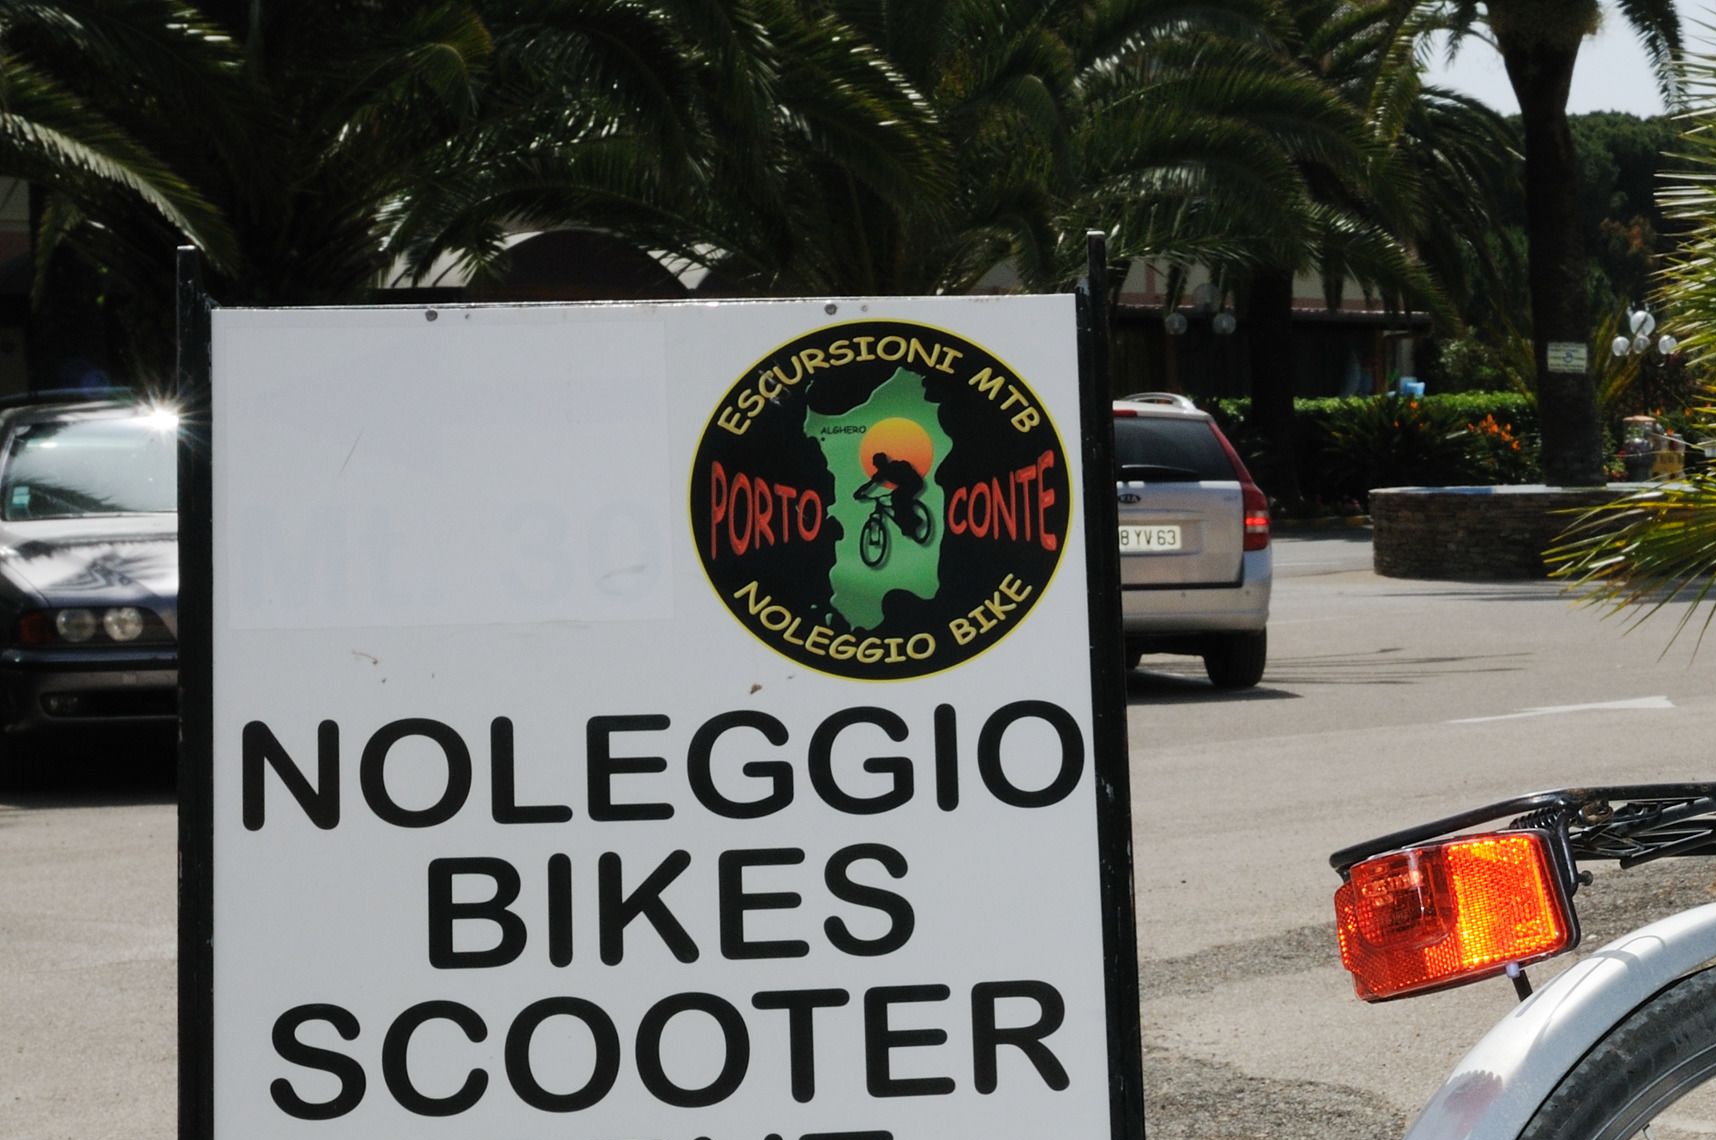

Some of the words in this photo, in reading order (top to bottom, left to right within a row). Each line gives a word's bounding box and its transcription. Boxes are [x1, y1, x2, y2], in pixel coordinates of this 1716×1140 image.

[717, 336, 963, 435] ESCURSIONI
[968, 367, 1041, 433] MTB
[820, 425, 867, 435] ALGHERO
[711, 460, 822, 560] PORTO
[949, 449, 1057, 551] CONTE
[1156, 529, 1176, 546] 63
[734, 581, 936, 663] NOLEGGIO
[949, 573, 1032, 645] BIKE
[243, 700, 1084, 831] NOLEGGIO
[428, 843, 914, 969] BIKES
[270, 980, 1069, 1120] SCOOTER
